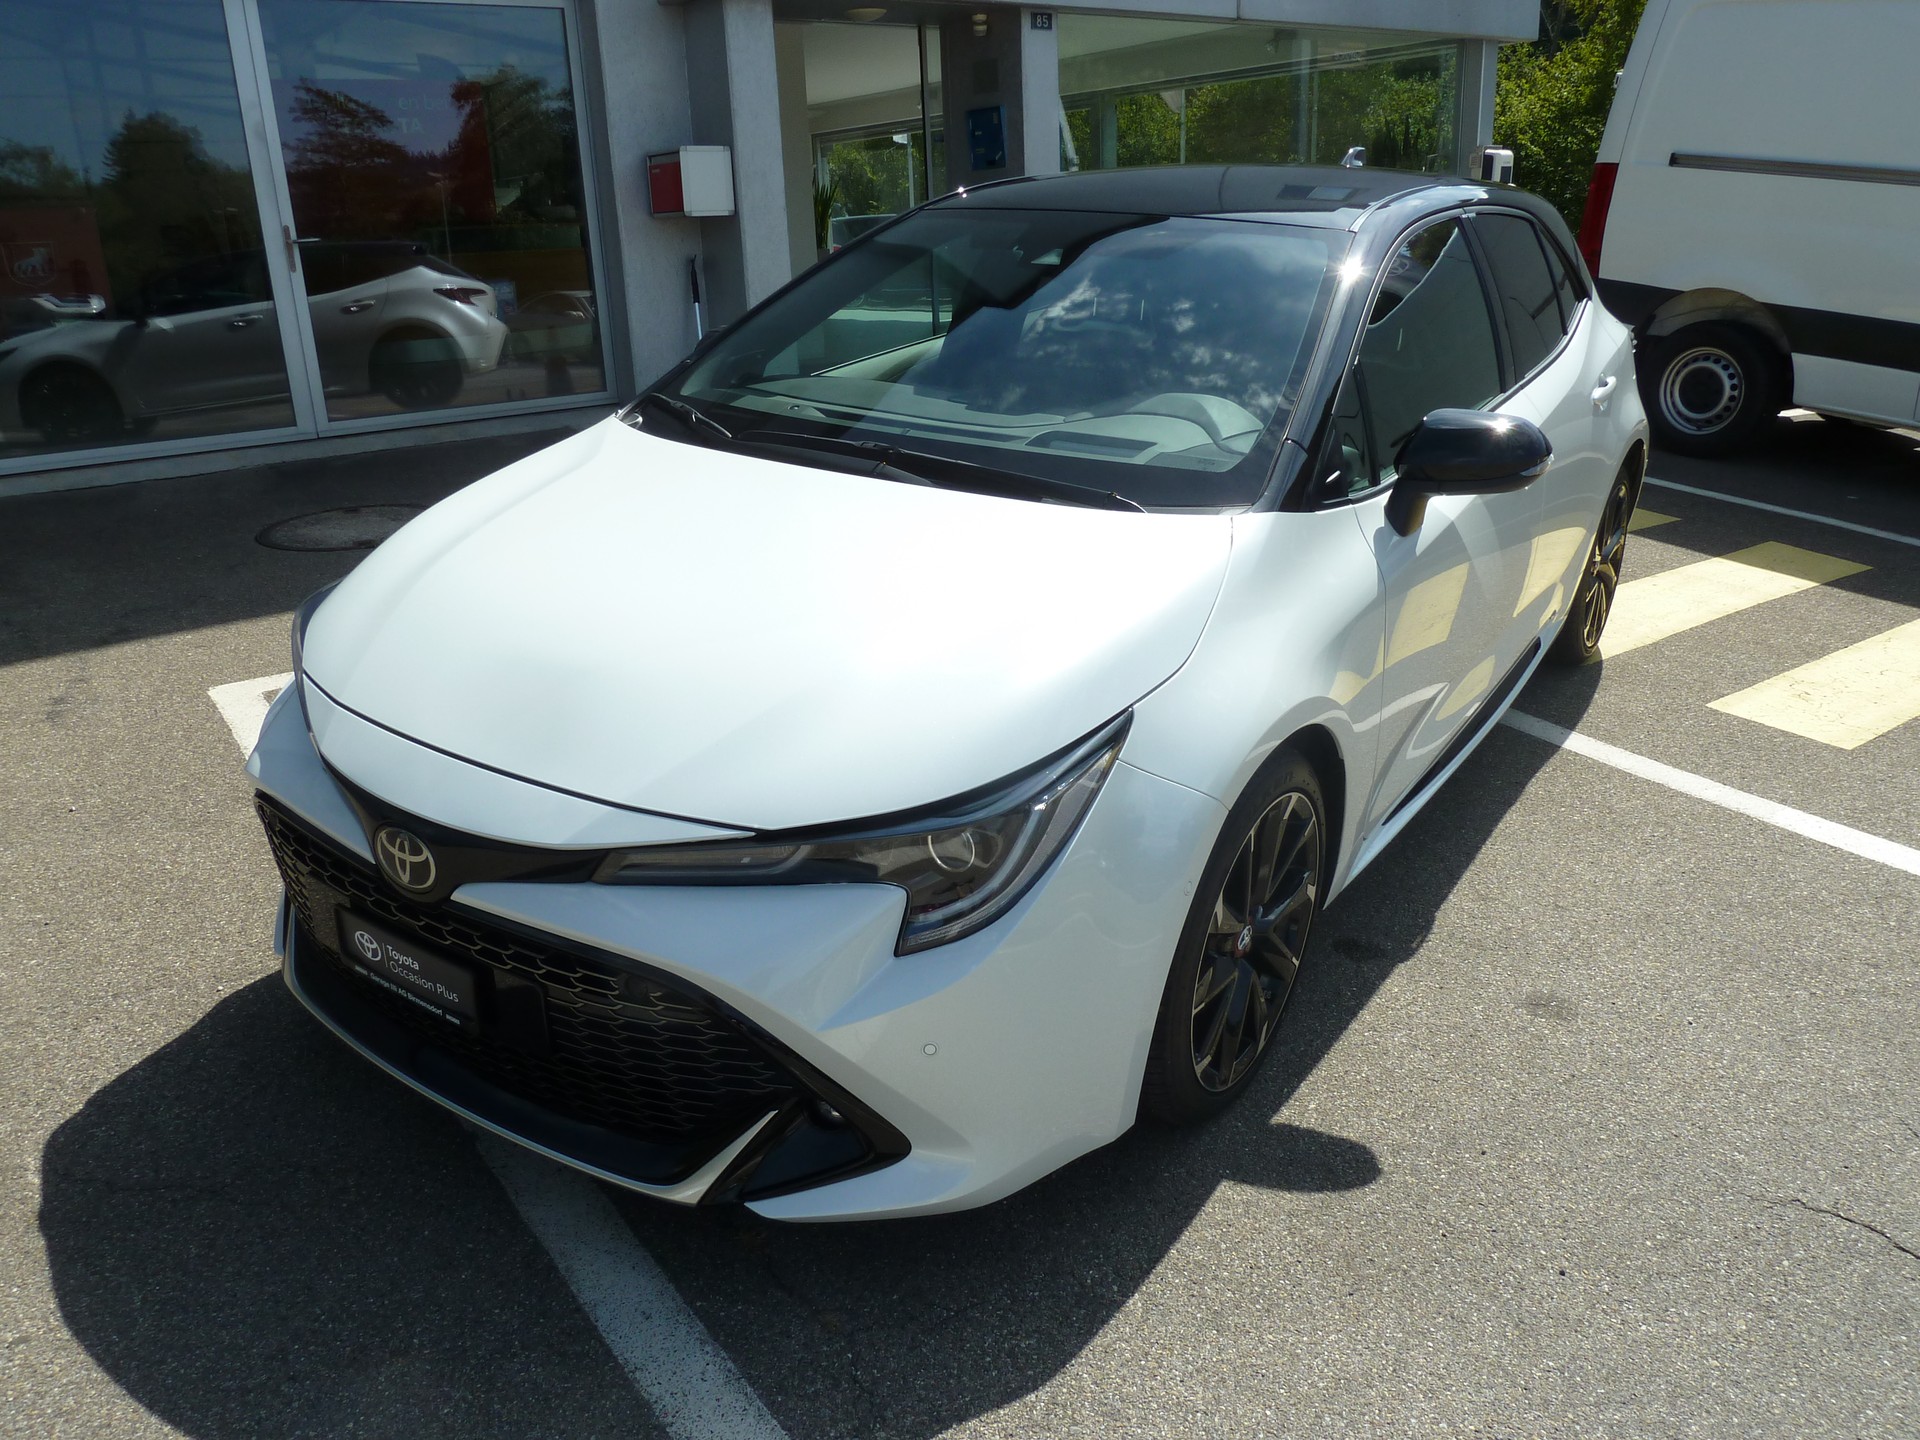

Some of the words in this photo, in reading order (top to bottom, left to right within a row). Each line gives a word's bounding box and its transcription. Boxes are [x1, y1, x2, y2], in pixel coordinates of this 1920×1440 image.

[1036, 14, 1049, 28] 85
[386, 945, 420, 970] Toyota
[389, 960, 435, 992] Occasion
[436, 983, 460, 1003] Plus
